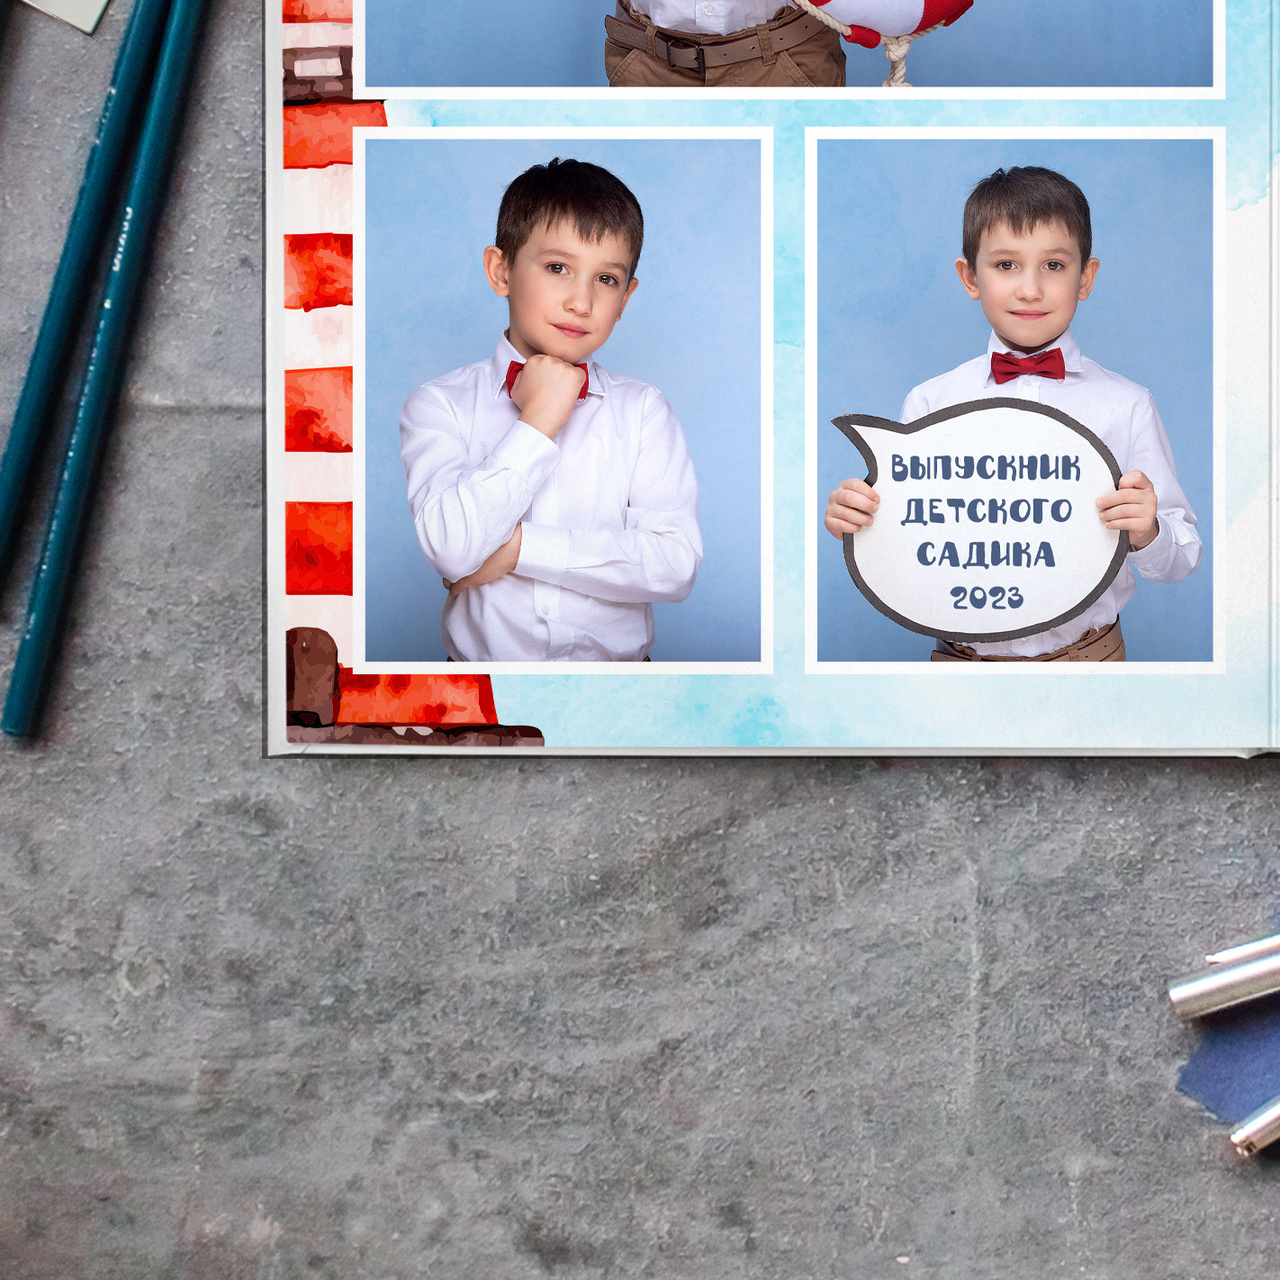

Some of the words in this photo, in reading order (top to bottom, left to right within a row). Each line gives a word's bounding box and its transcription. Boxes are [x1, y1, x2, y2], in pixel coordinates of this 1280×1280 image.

[891, 454, 1081, 482] ВЫПУСКНИК
[900, 498, 1072, 526] ДЕТСКОГО
[916, 540, 1056, 569] САДИКА
[950, 586, 1024, 610] 2023
